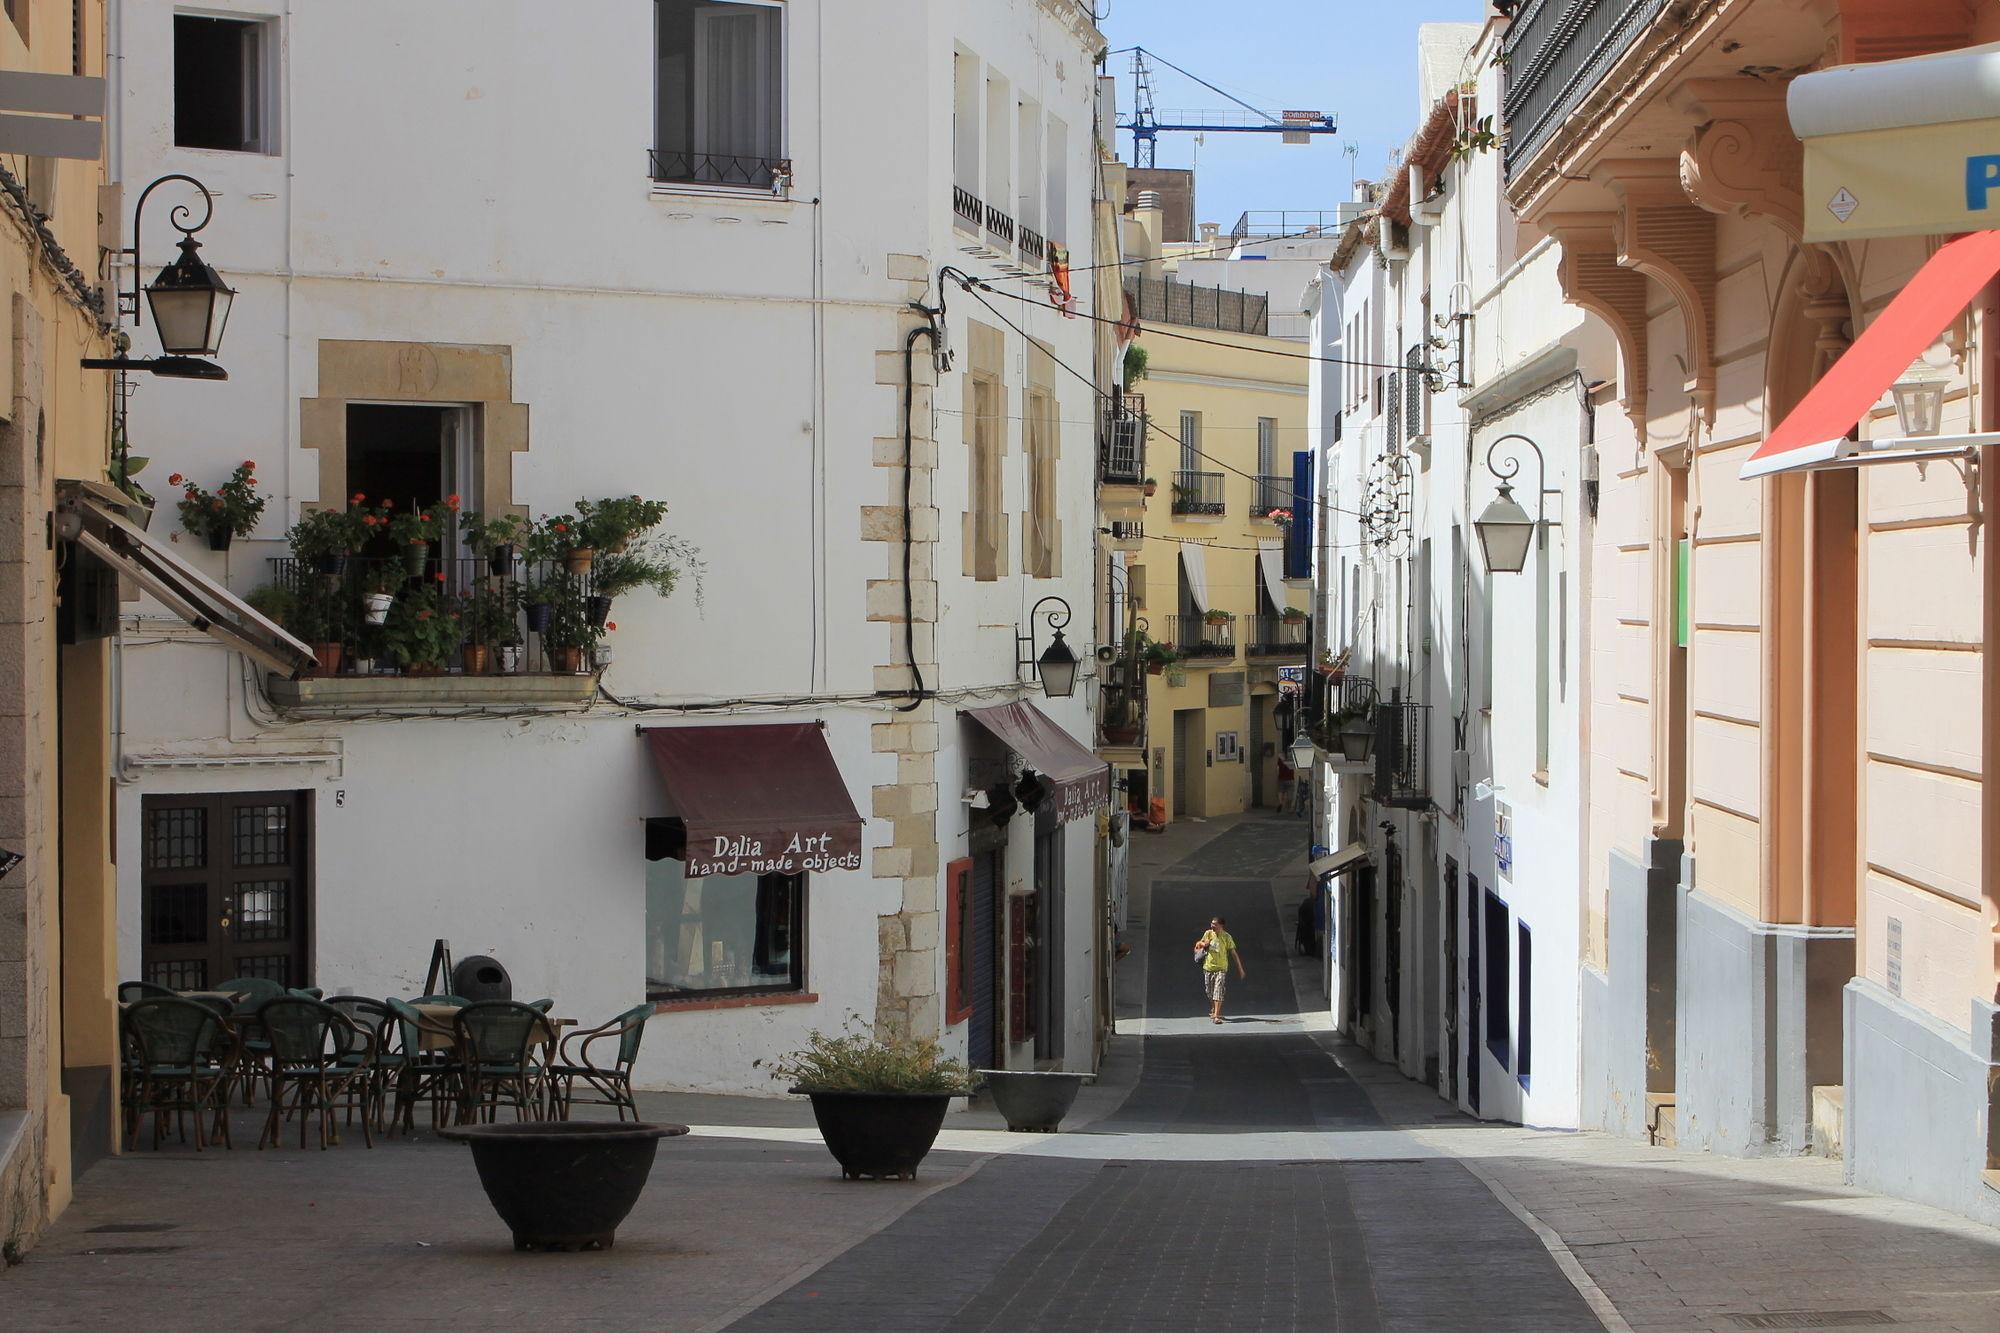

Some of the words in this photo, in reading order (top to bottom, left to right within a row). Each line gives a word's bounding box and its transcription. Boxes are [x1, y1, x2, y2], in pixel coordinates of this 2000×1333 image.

[336, 792, 344, 807] 5
[1064, 786, 1080, 806] Dalia
[1084, 780, 1100, 799] Art
[713, 834, 762, 858] Dalia
[783, 831, 833, 854] Art
[689, 855, 793, 876] hand-made
[803, 850, 860, 872] objects
